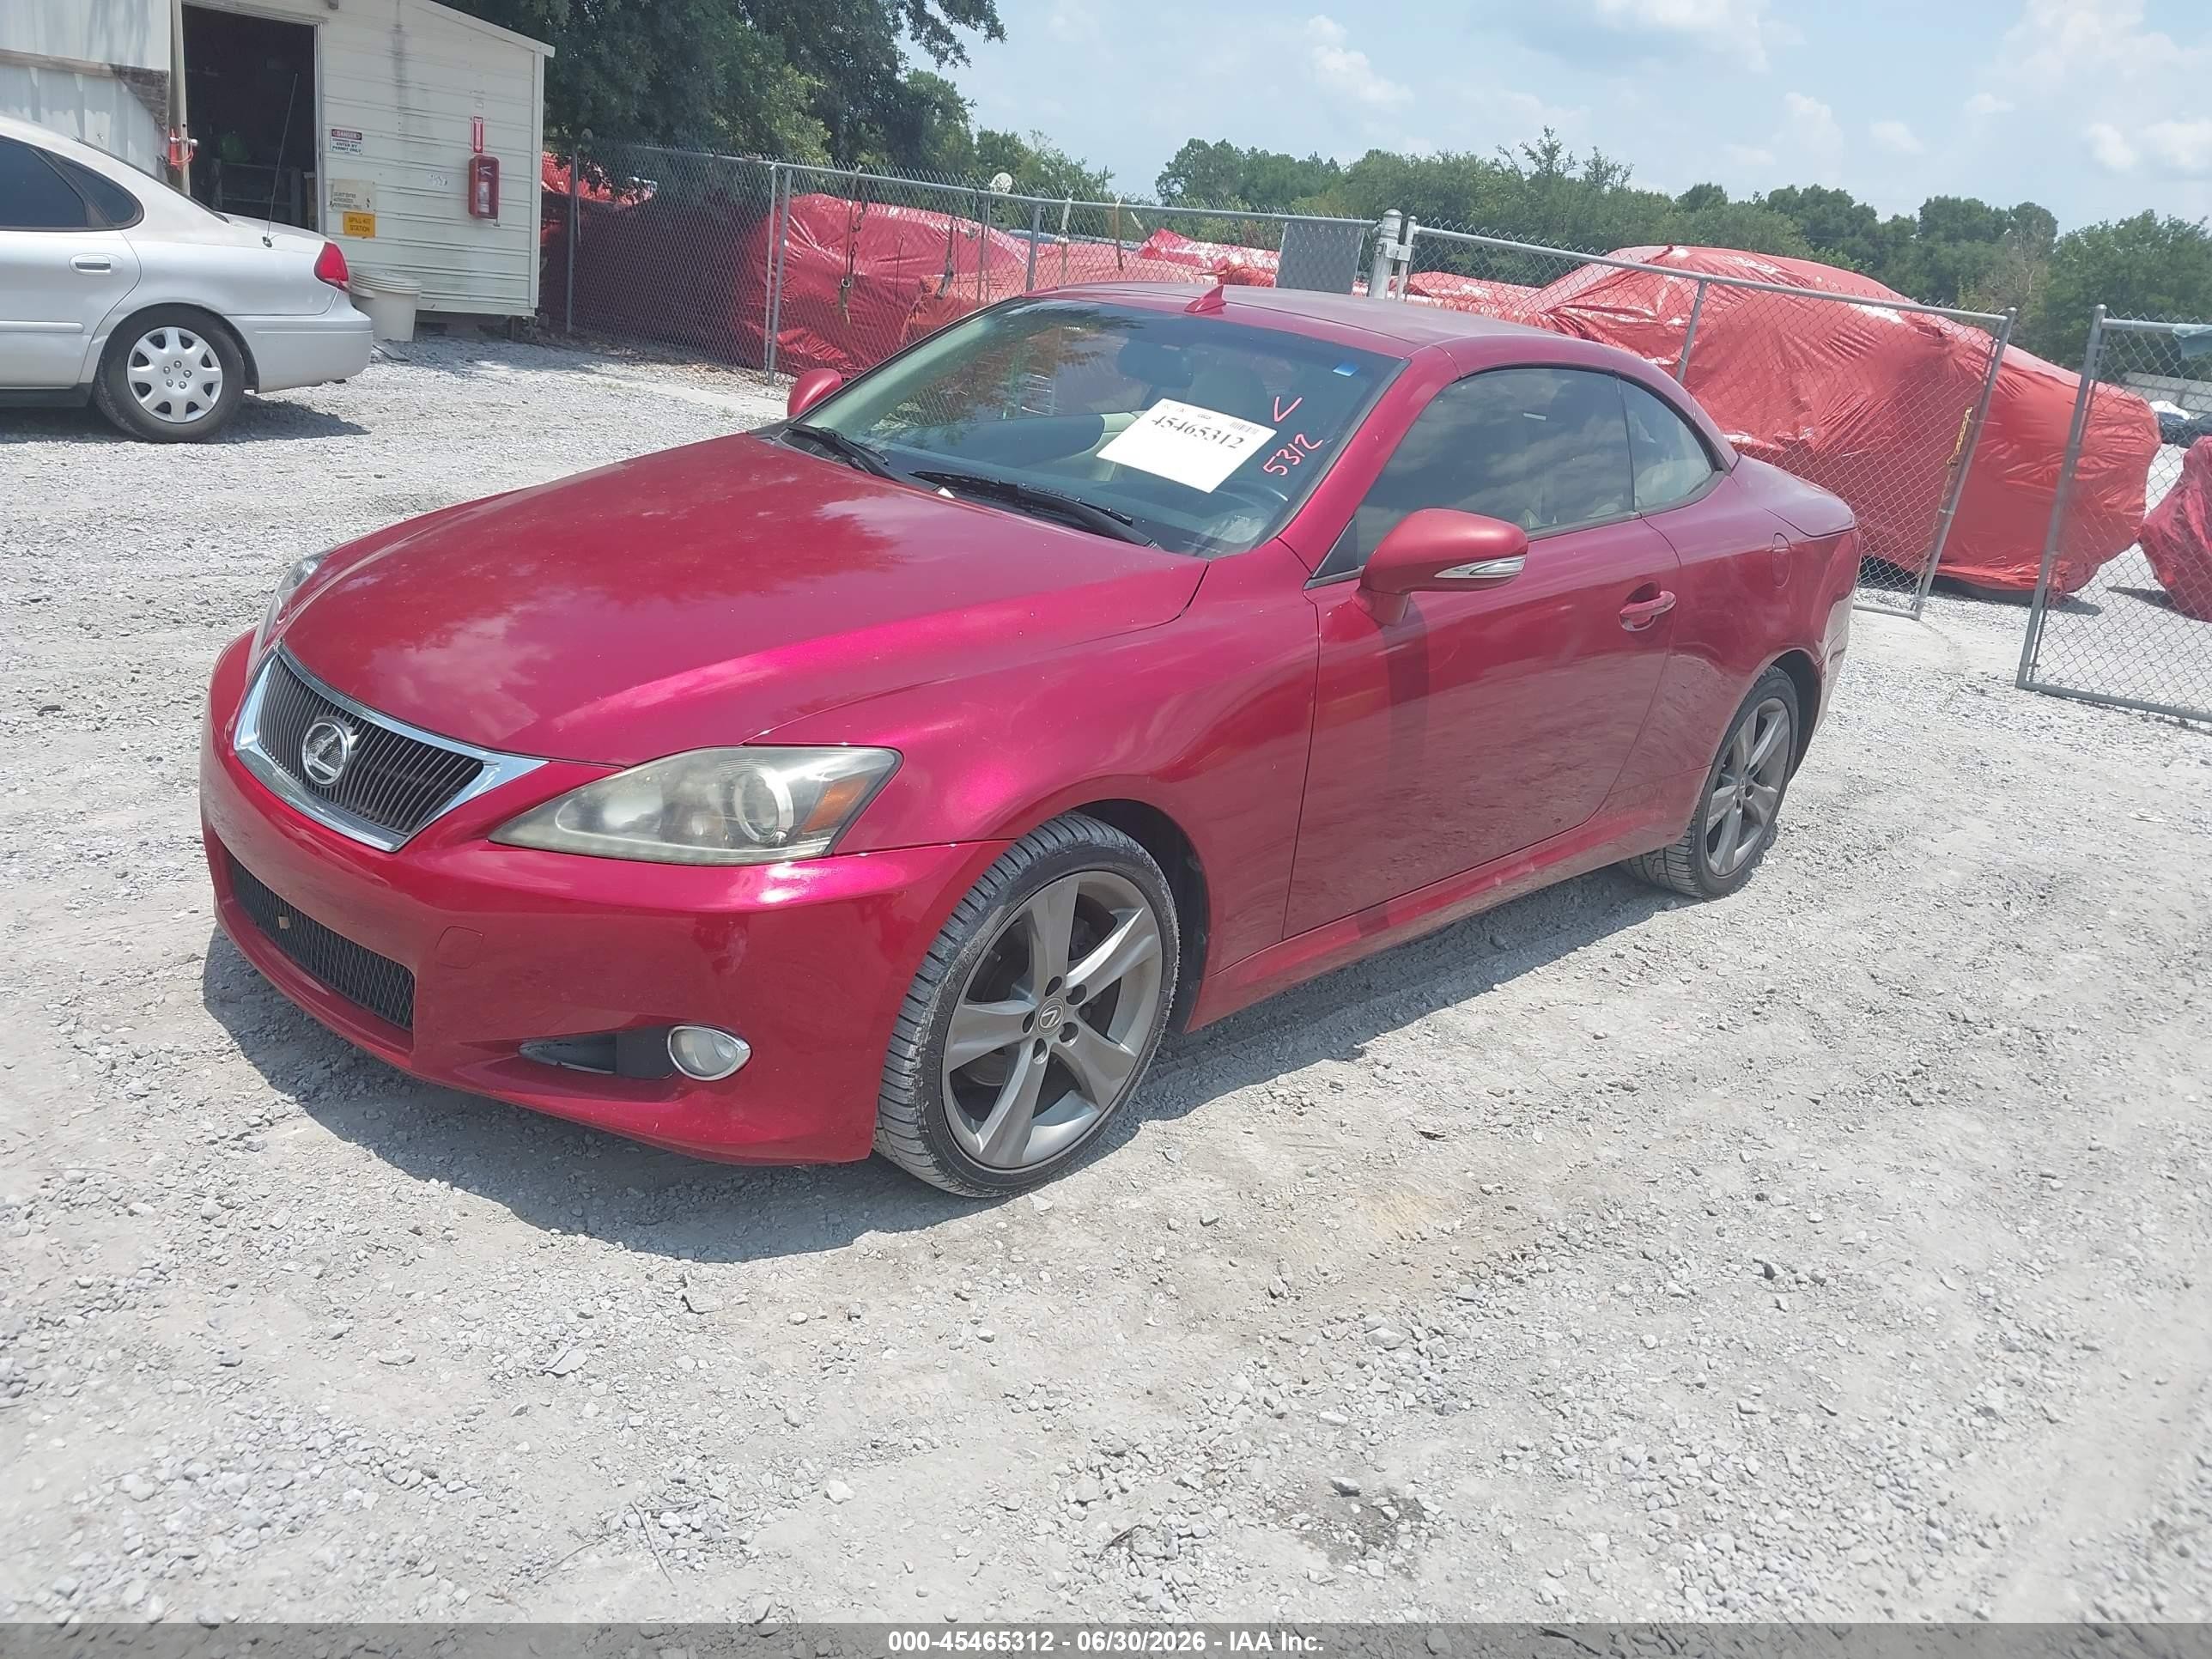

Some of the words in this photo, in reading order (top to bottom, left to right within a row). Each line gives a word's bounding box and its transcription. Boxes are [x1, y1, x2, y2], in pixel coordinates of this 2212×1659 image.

[337, 130, 356, 139] DANGER
[349, 224, 370, 233] STATION
[1152, 416, 1244, 449] 45465312
[1262, 433, 1324, 476] 5312
